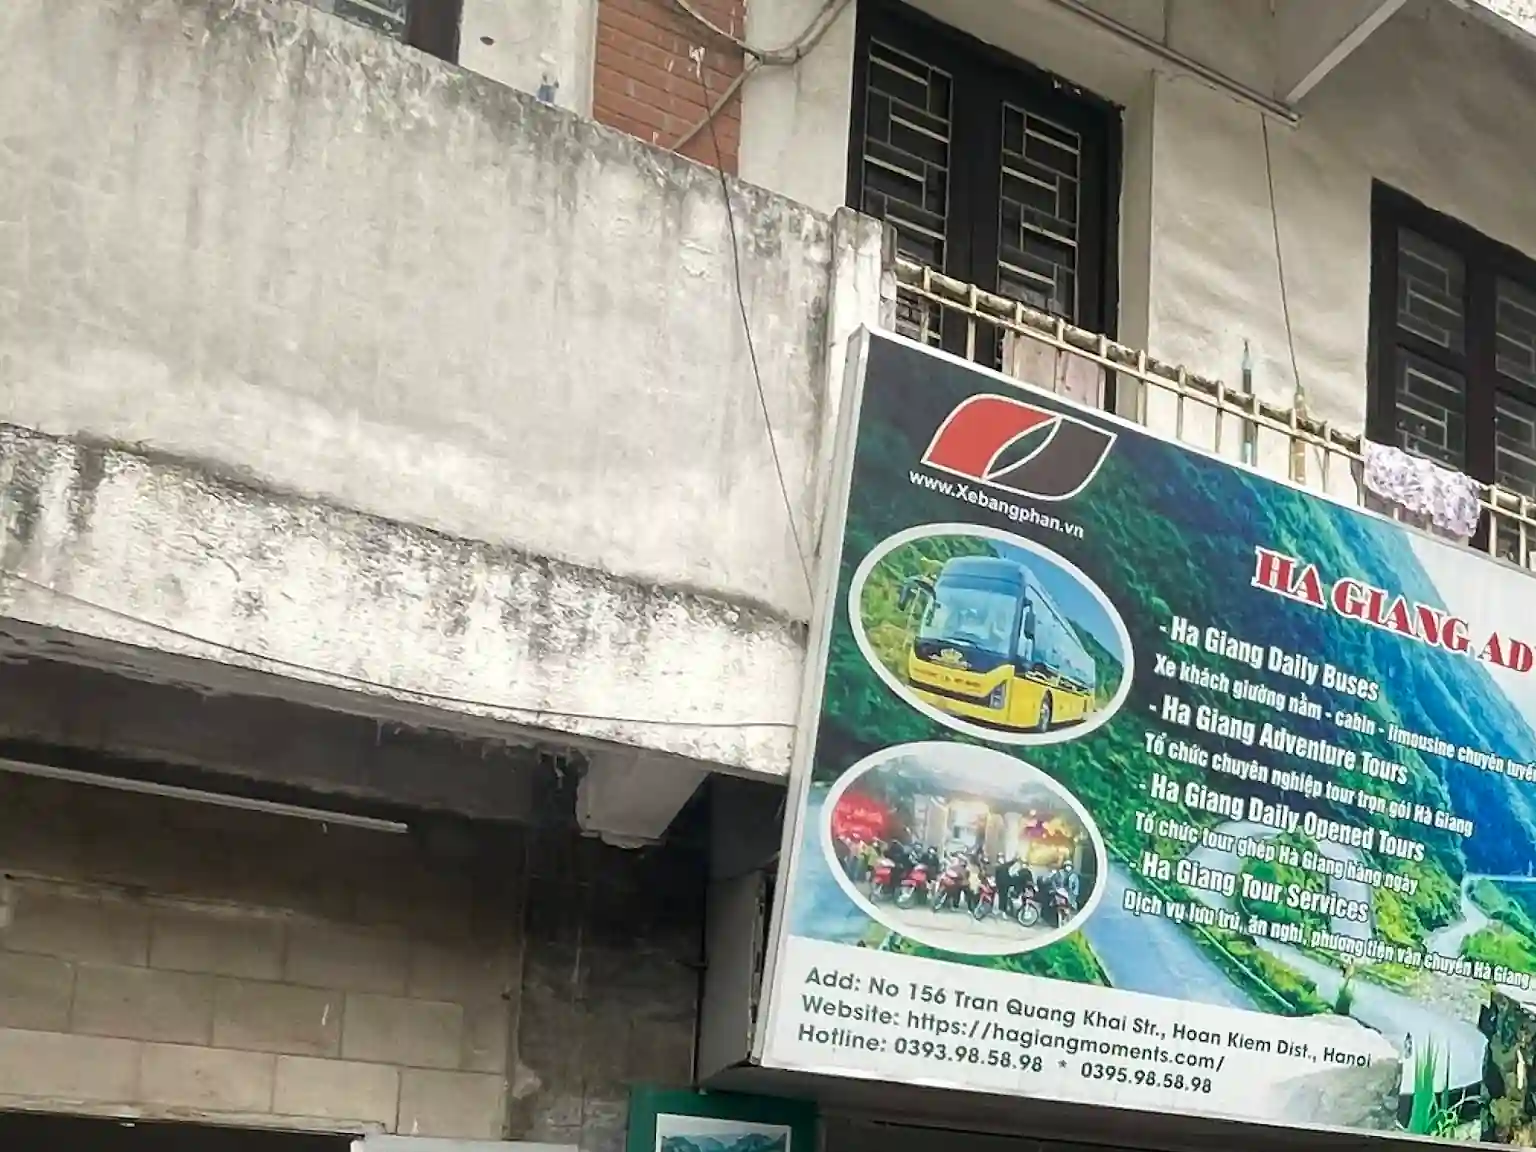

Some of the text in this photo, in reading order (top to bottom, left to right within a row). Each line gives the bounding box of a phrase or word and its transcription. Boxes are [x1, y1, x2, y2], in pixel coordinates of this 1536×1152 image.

[1251, 546, 1326, 609] HA
[1331, 577, 1471, 656] GIANG
[1171, 616, 1379, 701] Ha Giang Daily Buses
[1154, 652, 1176, 678] Xe
[1180, 660, 1229, 694] khách
[1233, 678, 1286, 713] giường
[1288, 691, 1322, 721] nằm
[1335, 708, 1376, 736] cabin
[1387, 721, 1455, 758] limousine
[1458, 745, 1504, 774] chuyên
[1162, 695, 1408, 785] Ha Giang Adventure Tours
[1145, 730, 1473, 838] Tổ chức chuyên nghiệp tour trọn gói Hà Giang
[1151, 774, 1425, 862] Ha Giang Daily Opened Tours
[1135, 811, 1418, 896] Tổ chức tour ghép Hà Giang hàng ngày
[1143, 852, 1369, 923] Ha Giang Tour Services
[1124, 889, 1161, 917] Dịch
[1165, 899, 1186, 919] vụ
[1189, 902, 1215, 926] lưu
[1310, 929, 1367, 957] phương
[1367, 940, 1394, 962] tiện
[1397, 948, 1422, 969] vận
[1473, 960, 1492, 980] Hà
[1493, 967, 1530, 990] Giang
[797, 1023, 1212, 1094] Hotline: 0393.98.58.98 0395.98.58.98
[801, 994, 1226, 1074] Website: https://hagiangmoments.com/
[805, 967, 1372, 1069] Add: No 156 Tran Quang Khai Str., Hoan Kiem Dist., Hanoi
